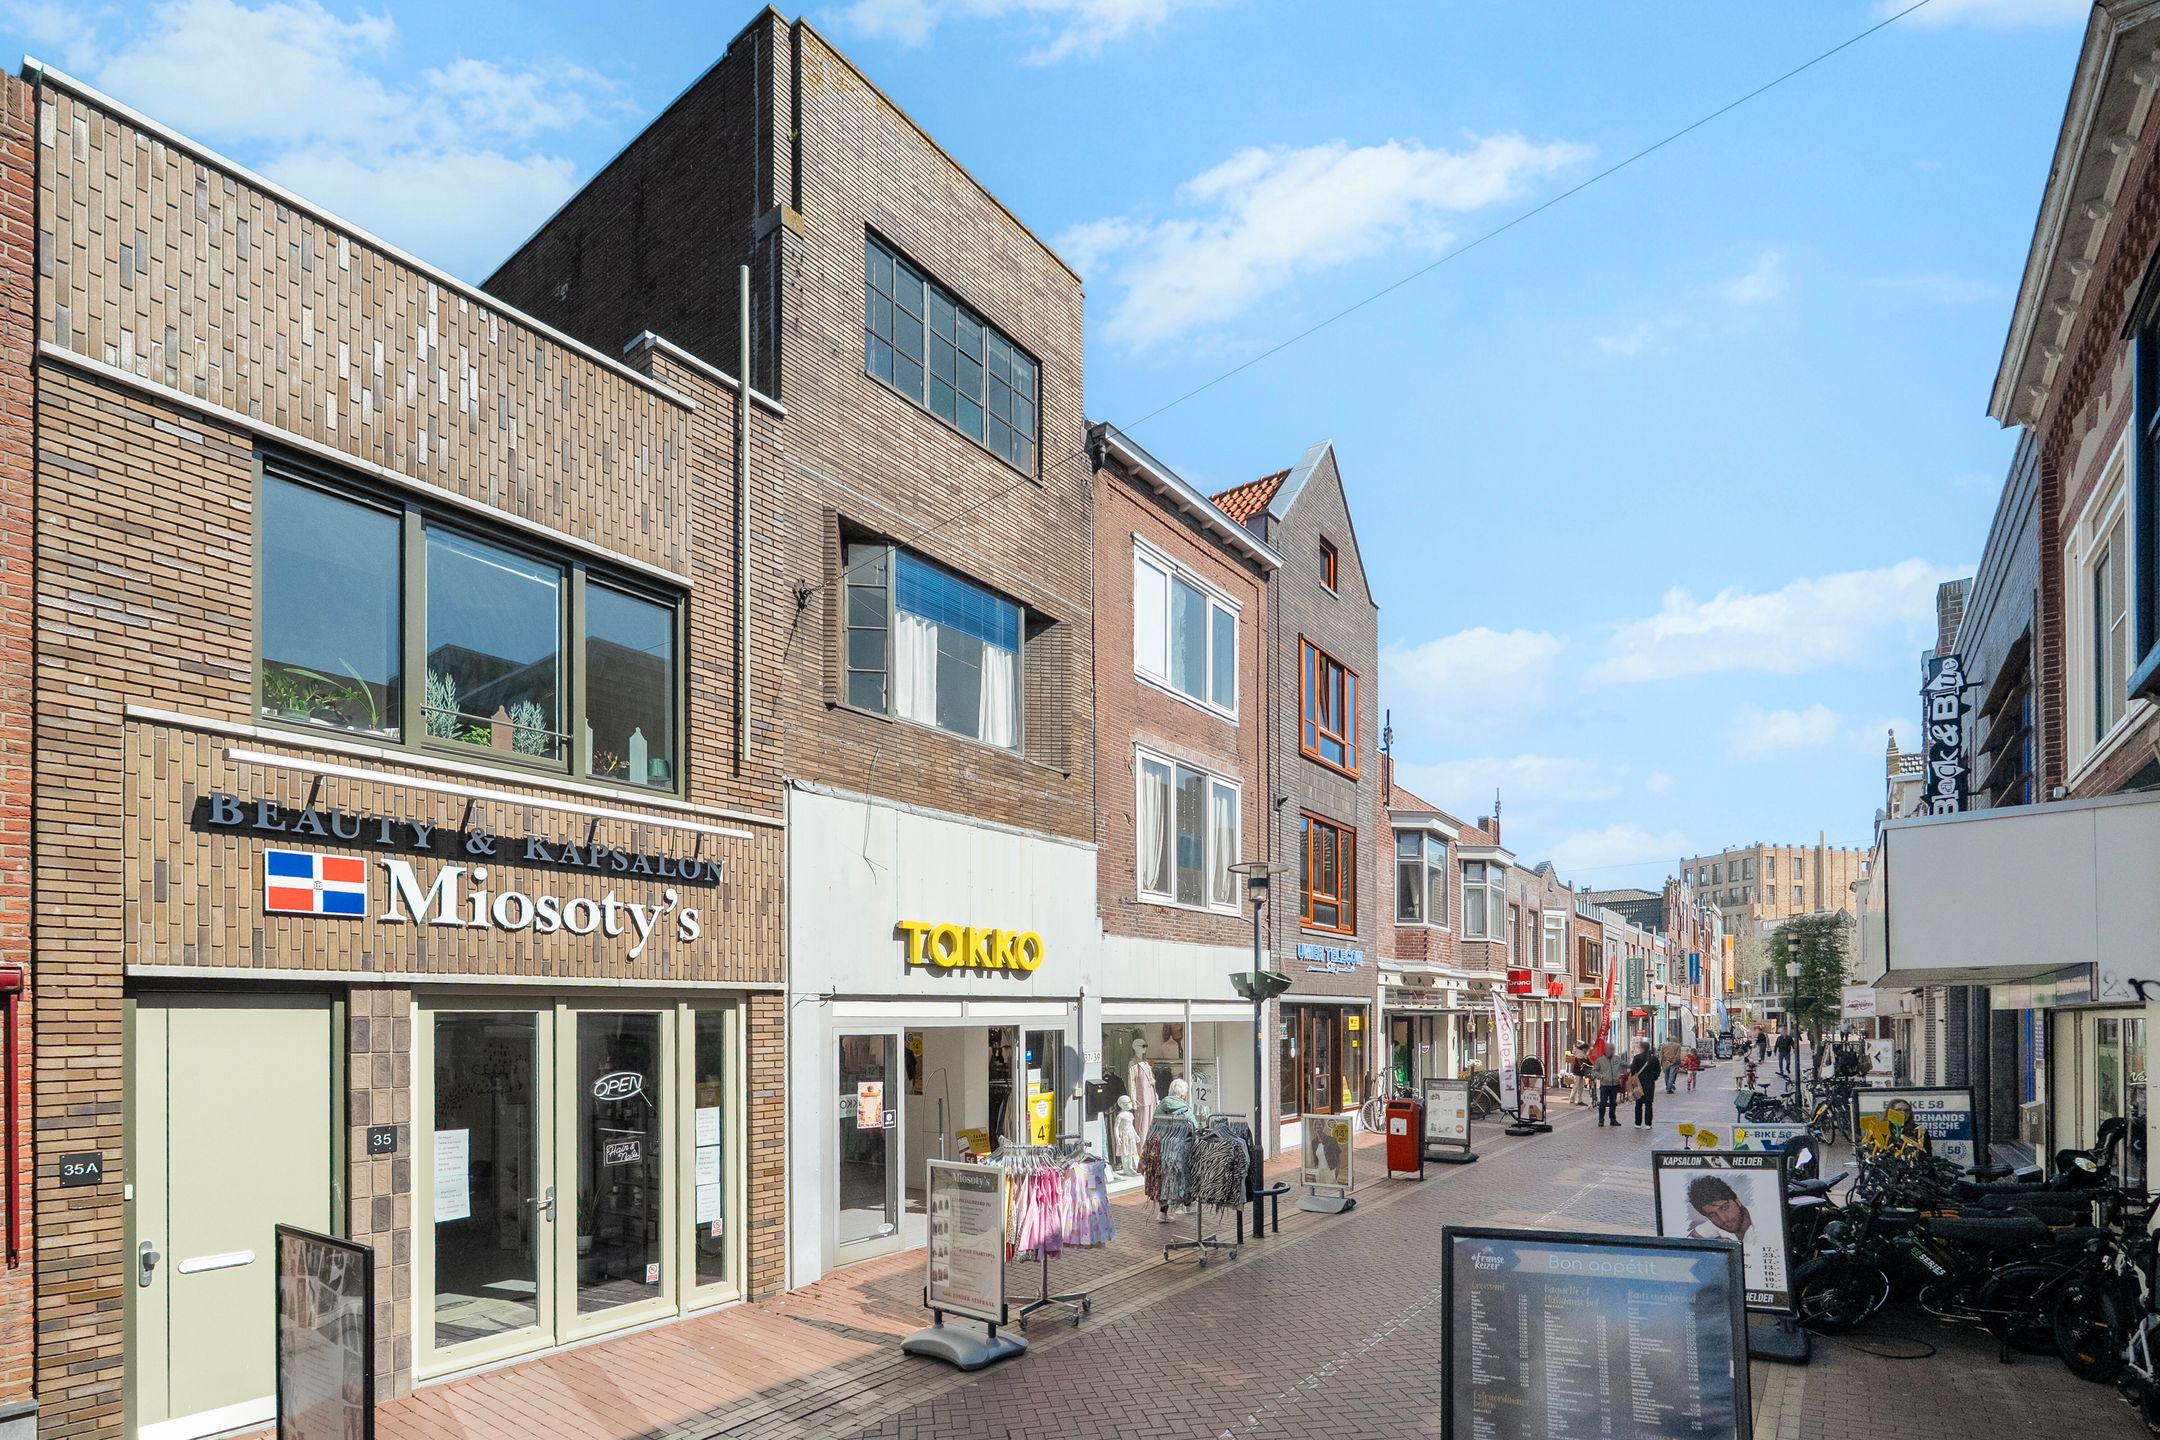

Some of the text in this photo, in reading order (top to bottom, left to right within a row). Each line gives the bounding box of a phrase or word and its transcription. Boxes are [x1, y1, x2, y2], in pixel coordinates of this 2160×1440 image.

[1931, 657, 1960, 721] Blue
[1931, 724, 1960, 747] &
[208, 791, 727, 882] BEAUTY & KAPSALON
[380, 858, 703, 959] Miosoty's
[898, 920, 1045, 971] TAKKO
[1325, 946, 1364, 967] TELECOM
[594, 1076, 642, 1097] OPEN
[1928, 1100, 1944, 1109] 58
[373, 1134, 392, 1146] 35
[1947, 1146, 1961, 1154] 58
[63, 1162, 99, 1176] 35A
[1663, 1156, 1763, 1166] KAPSALON HELDER
[952, 1171, 991, 1189] Miosoty's
[1548, 1254, 1657, 1276] Bon appétit
